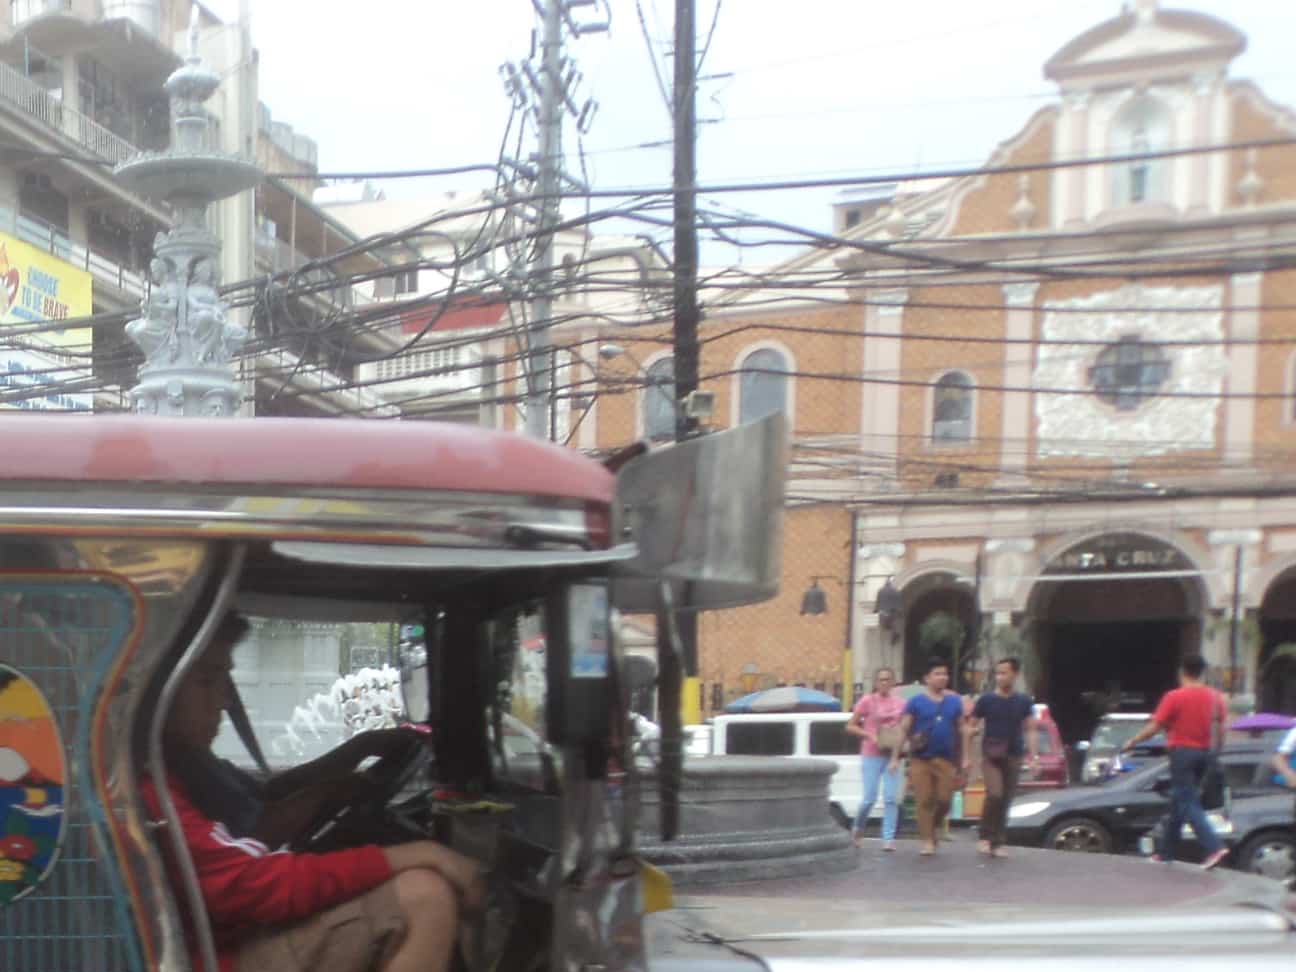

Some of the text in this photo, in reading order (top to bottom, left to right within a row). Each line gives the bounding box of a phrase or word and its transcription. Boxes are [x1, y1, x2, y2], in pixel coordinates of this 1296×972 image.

[22, 285, 32, 307] TO
[32, 291, 43, 313] BE
[43, 296, 69, 320] BRAVE
[1117, 550, 1177, 566] CRUZ
